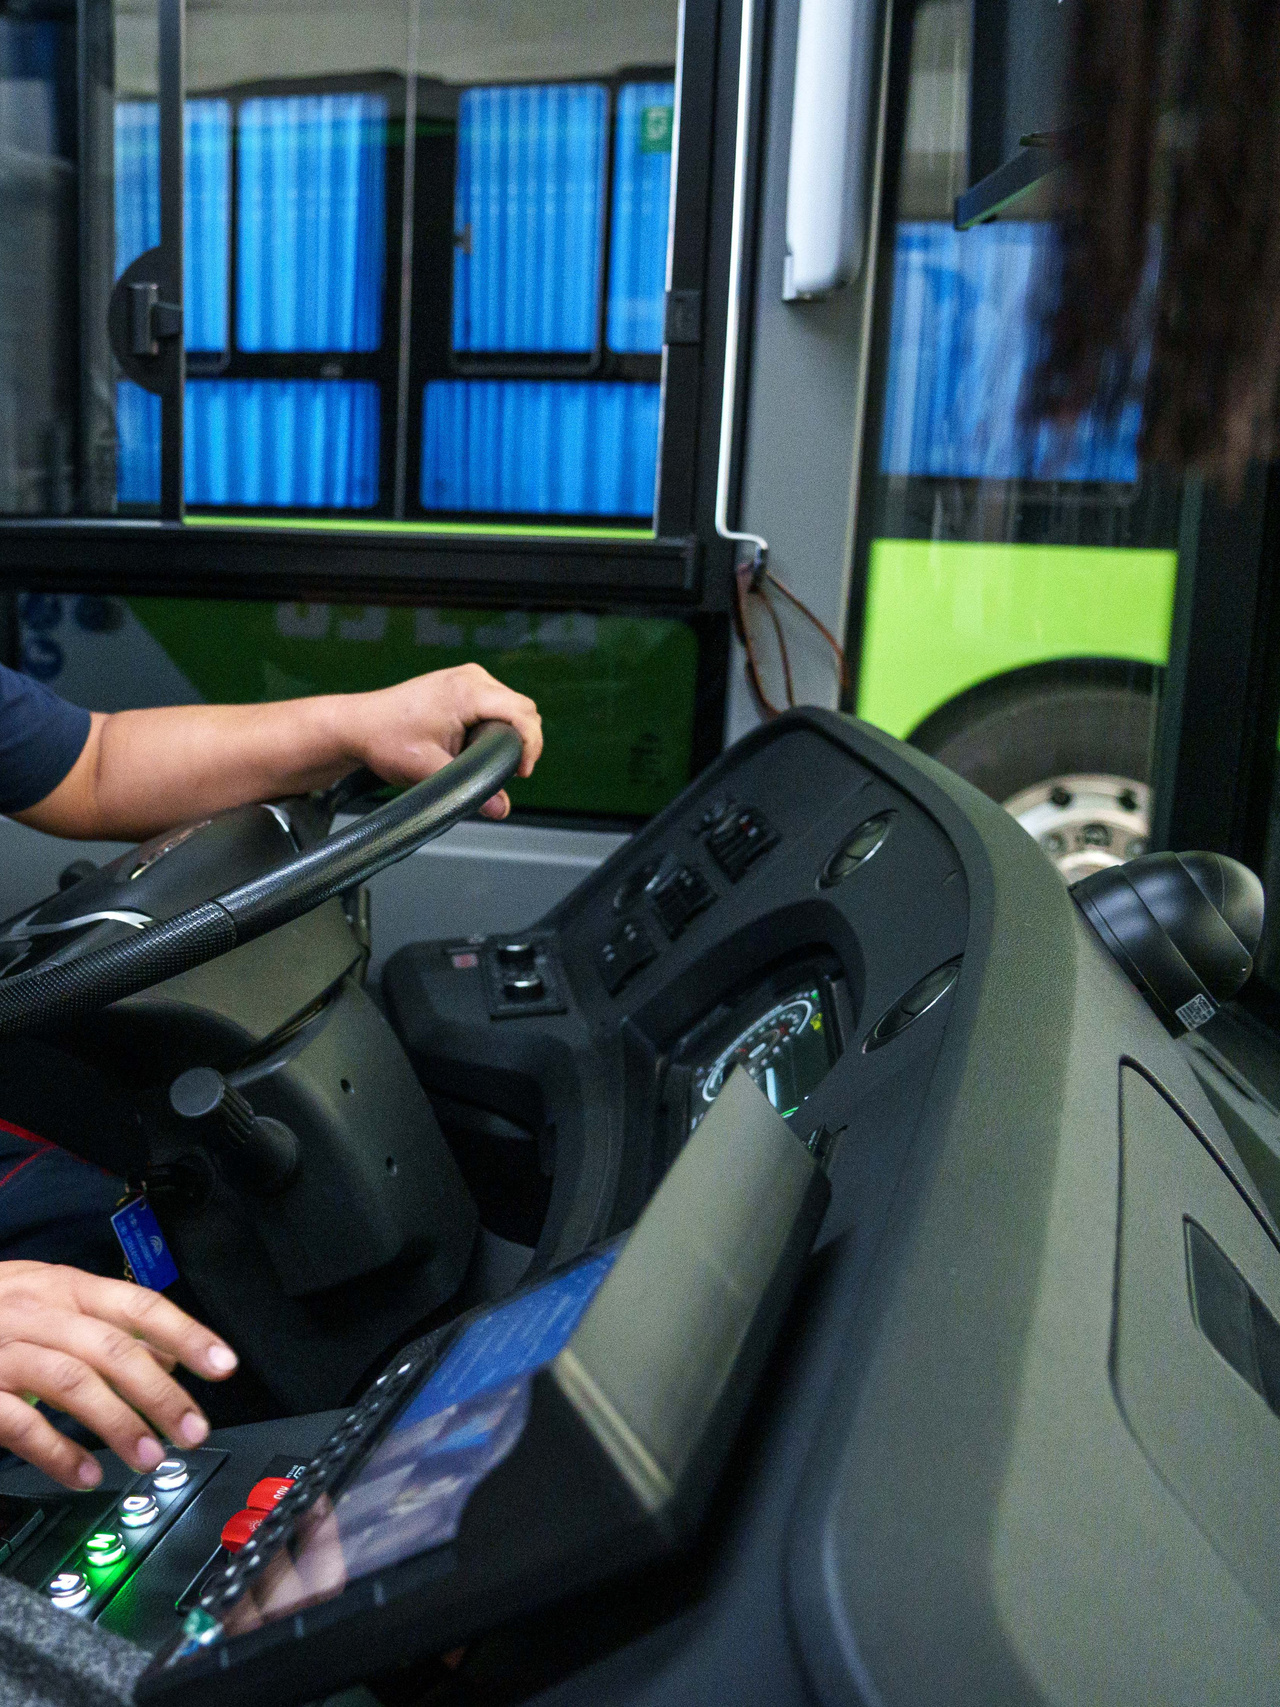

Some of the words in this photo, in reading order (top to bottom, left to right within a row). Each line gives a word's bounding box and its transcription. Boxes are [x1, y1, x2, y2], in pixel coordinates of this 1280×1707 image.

[123, 1496, 150, 1511] D
[86, 1533, 117, 1549] N
[50, 1573, 80, 1590] R
